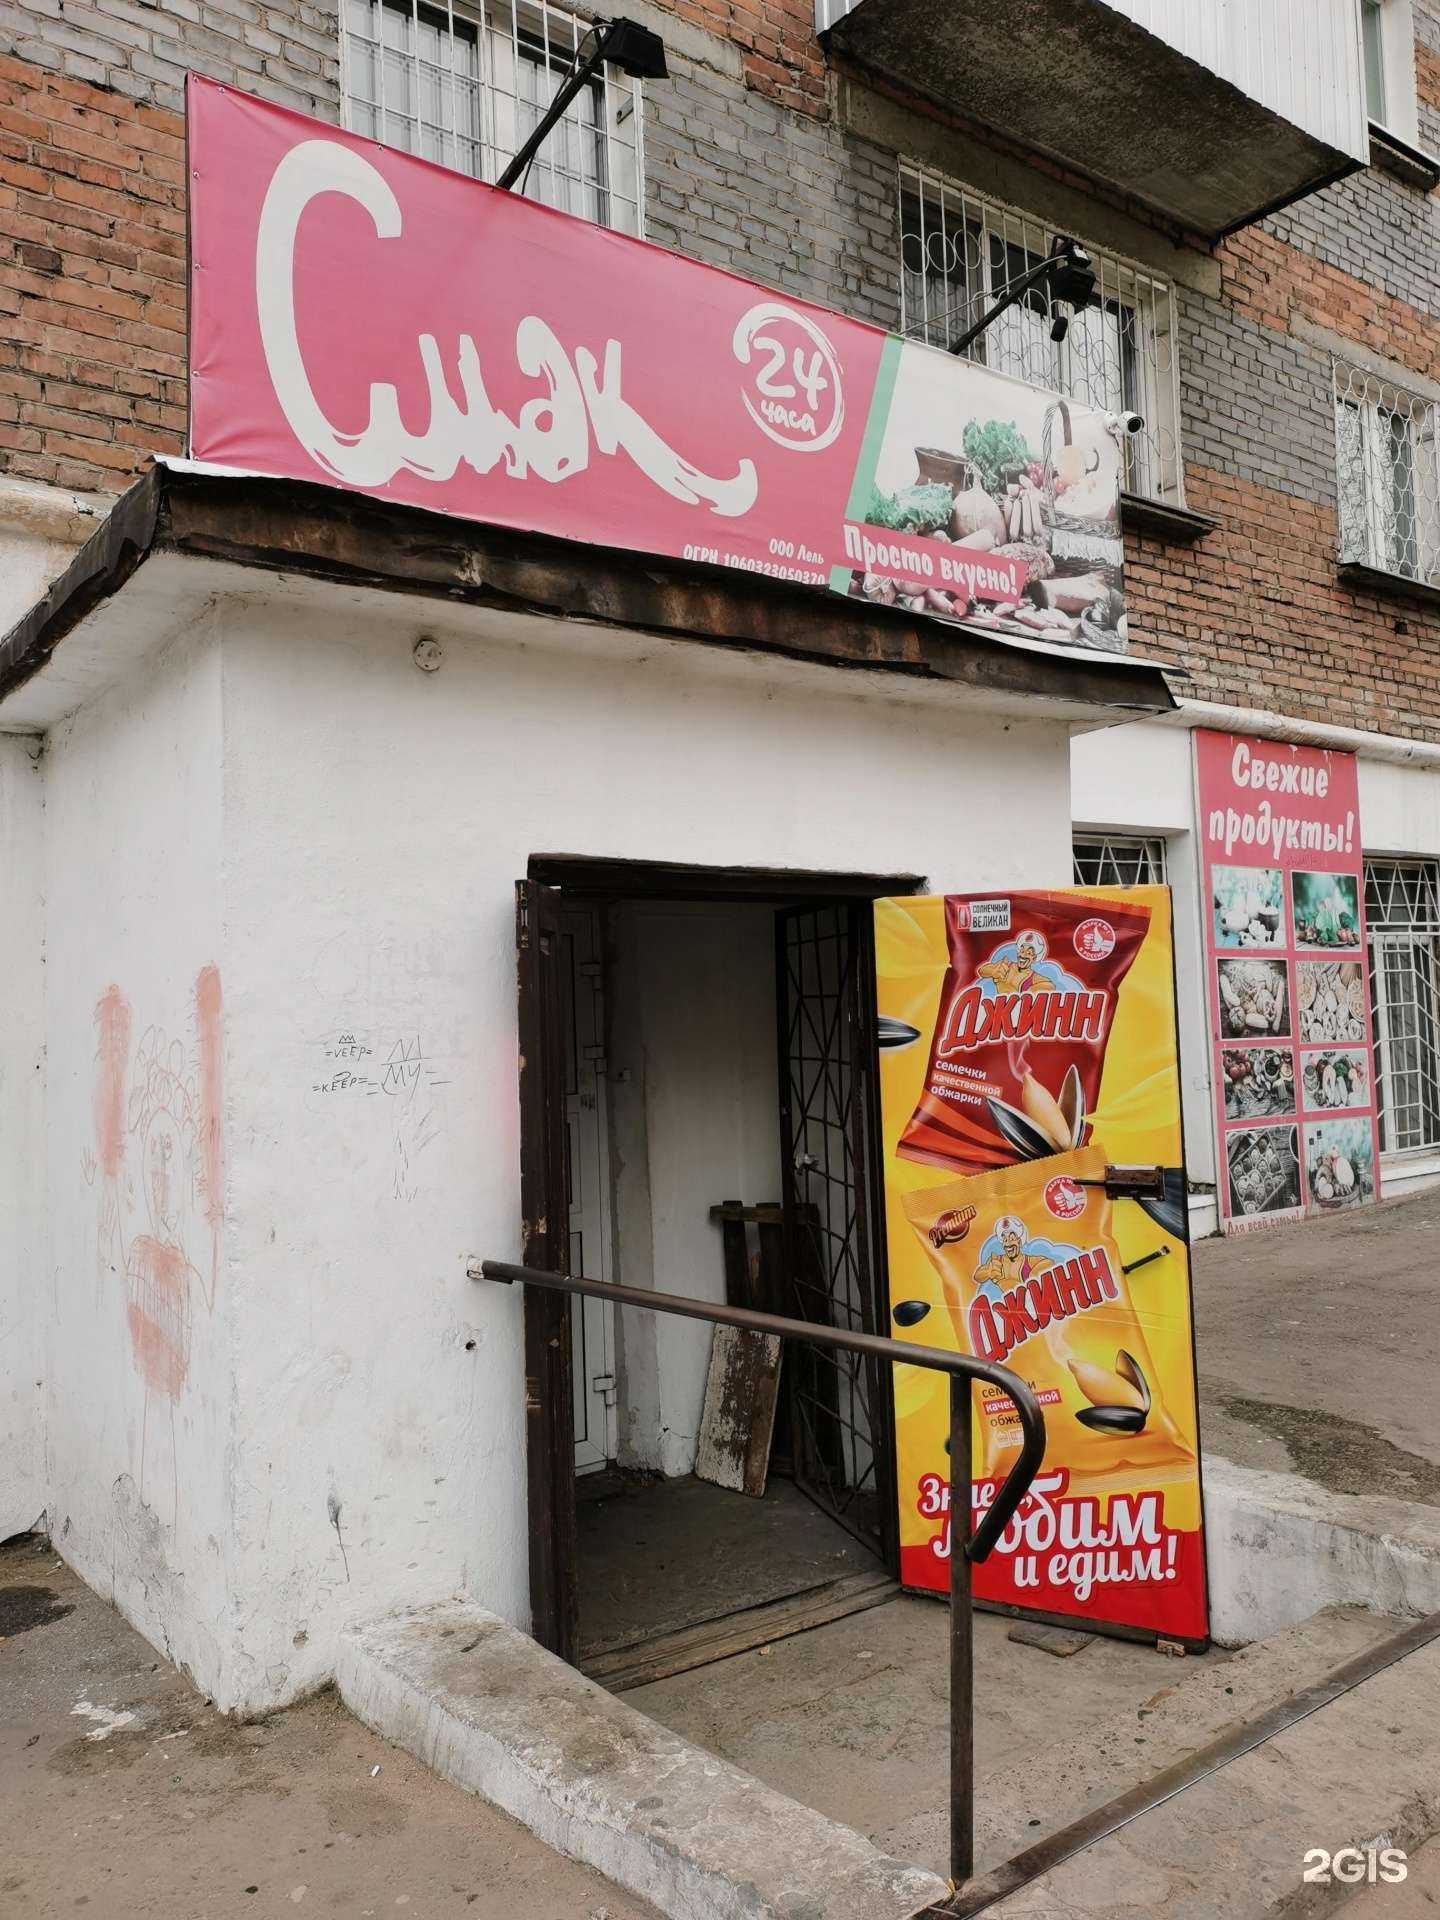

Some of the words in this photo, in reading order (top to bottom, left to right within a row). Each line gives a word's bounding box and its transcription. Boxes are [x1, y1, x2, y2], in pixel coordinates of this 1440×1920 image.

[256, 139, 758, 517] Смак
[753, 336, 828, 411] 24
[760, 399, 816, 436] часа
[683, 543, 719, 565] ОГРН
[768, 538, 794, 558] ООО
[797, 544, 825, 565] Лель
[843, 524, 934, 573] Просто
[940, 556, 1018, 597] вкусно!
[1232, 742, 1329, 798] Свежие
[1209, 800, 1355, 860] продукты!
[973, 915, 1009, 928] ВЕЛИКАН
[932, 1073, 1001, 1097] качественной
[935, 1060, 987, 1080] семечки
[930, 1085, 982, 1105] обжарки
[929, 1205, 977, 1249] Premium
[1014, 1556, 1040, 1588] и
[1048, 1535, 1177, 1601] едим!
